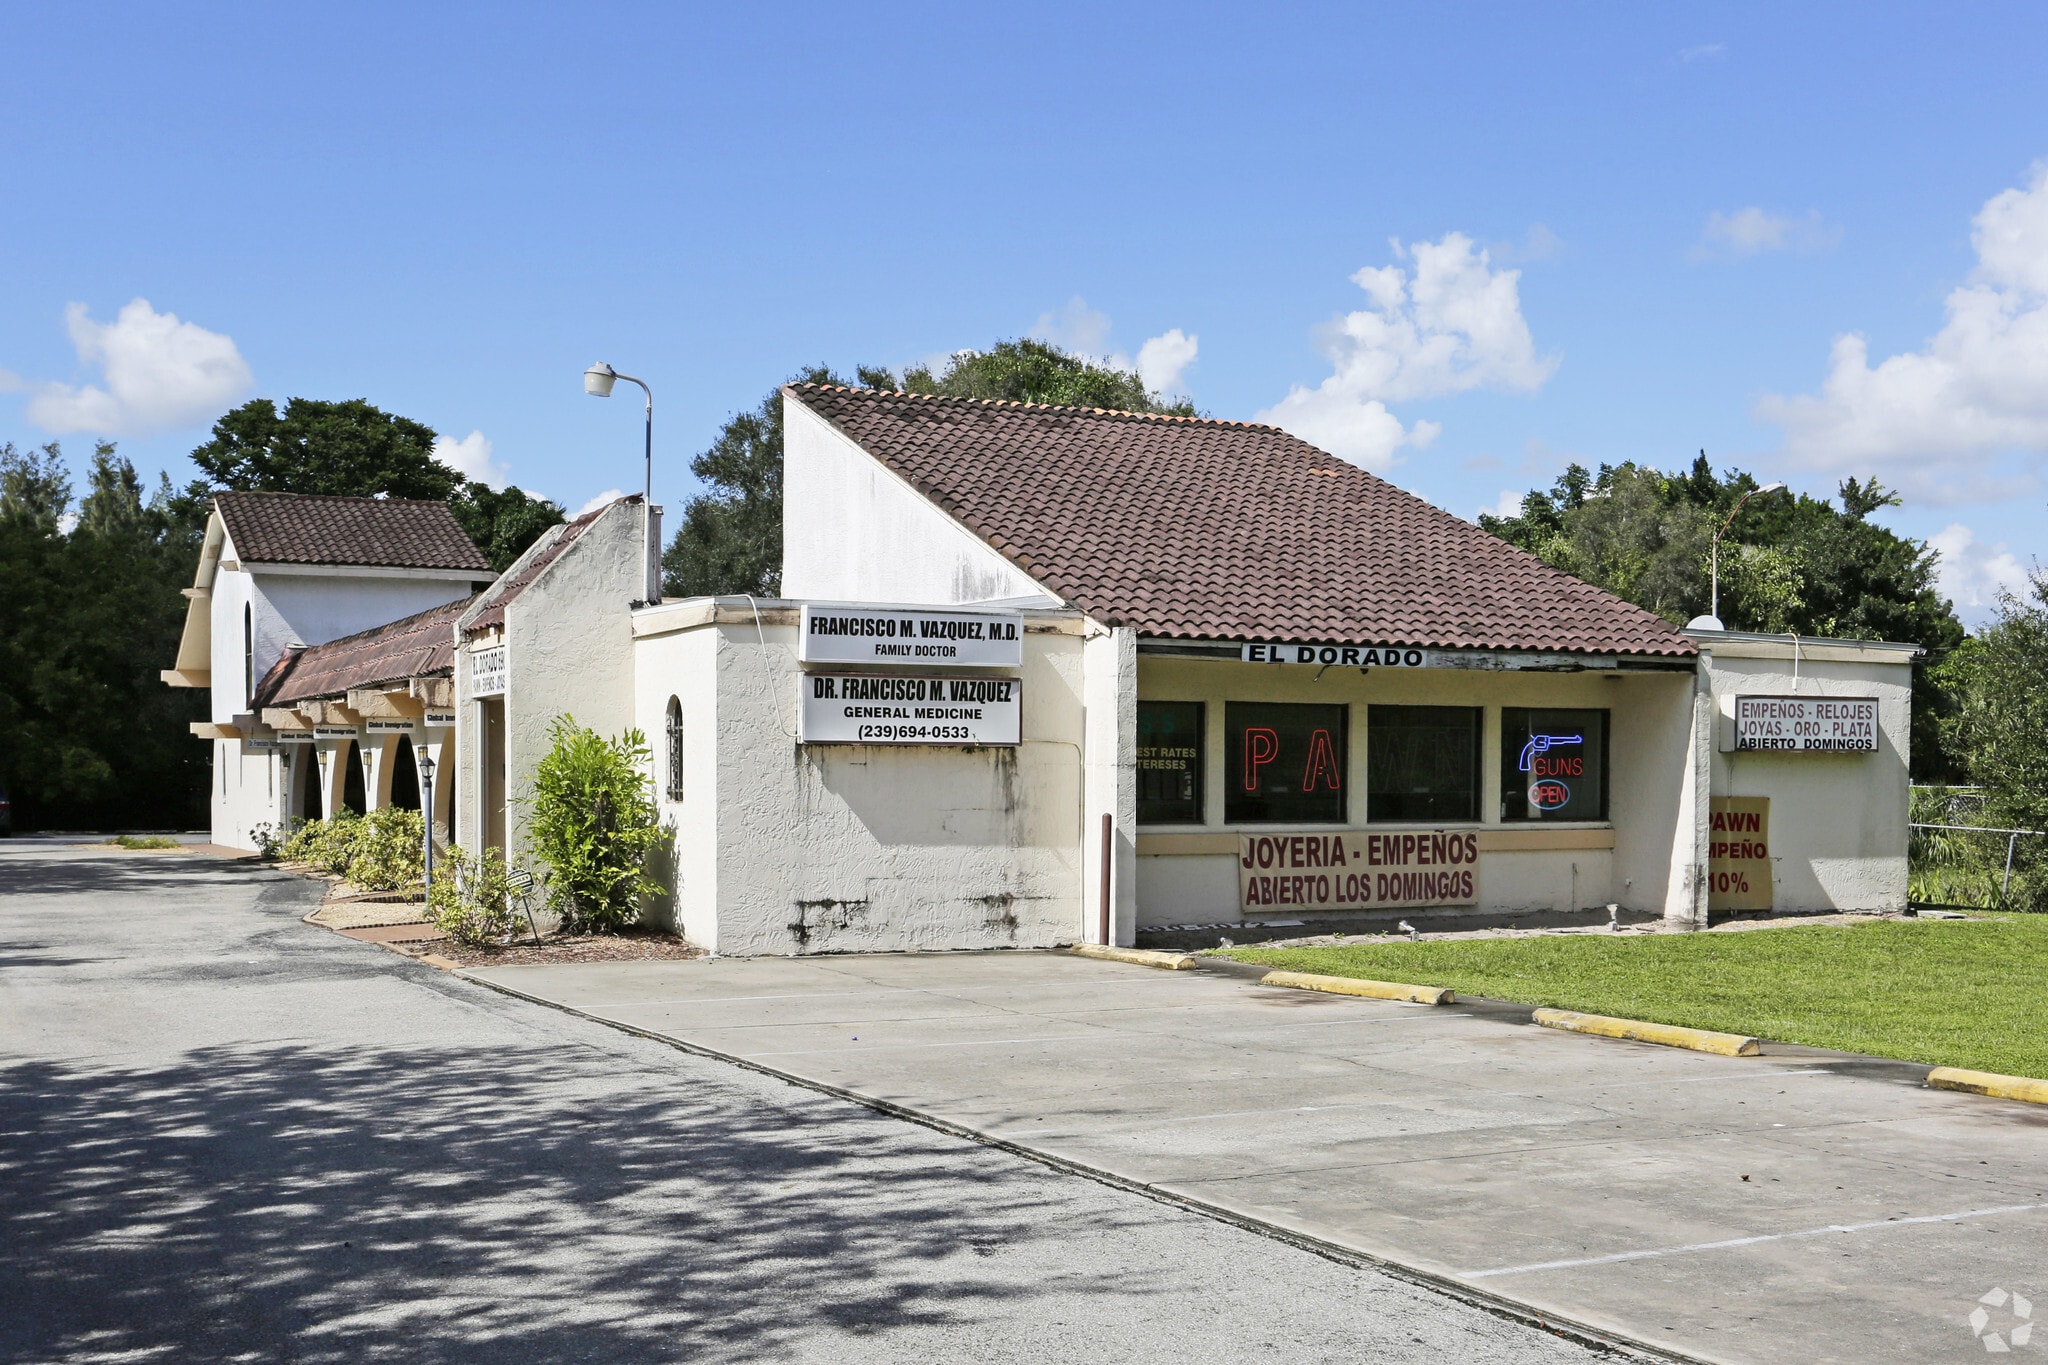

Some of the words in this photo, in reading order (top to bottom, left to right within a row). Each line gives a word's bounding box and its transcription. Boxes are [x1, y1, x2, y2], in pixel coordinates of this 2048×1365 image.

[810, 616, 896, 637] FRANCISCO
[899, 620, 917, 638] M.
[920, 620, 986, 642] VAZQUEZ,
[988, 622, 1019, 641] M.D.
[875, 644, 912, 657] FAMILY
[915, 645, 956, 658] DOCTOR
[1248, 644, 1285, 663] EL
[1297, 646, 1423, 667] DORADO
[813, 677, 838, 699] DR.
[842, 678, 926, 701] FRANCISCO
[929, 680, 946, 702] M.
[950, 681, 1012, 705] VAZQUEZ
[843, 706, 910, 719] GENERAL
[914, 708, 982, 720] MEDICINE
[1816, 704, 1873, 720] RELOJES
[858, 725, 969, 741] (239)694-0533
[1740, 720, 1782, 736] JOYAS
[1794, 721, 1821, 736] ORO
[1833, 722, 1872, 738] PLATA
[1160, 747, 1197, 758] RATES
[1738, 738, 1796, 749] ABIERTO
[1804, 738, 1873, 750] DOMINGOS
[1533, 757, 1583, 776] GUNS
[1530, 786, 1566, 803] OPEN
[1242, 835, 1346, 869] JOYERIA
[1368, 829, 1477, 866] EMPEÑOS
[1246, 874, 1329, 906] ABIERTO
[1336, 873, 1371, 903] LOS
[1377, 870, 1473, 902] DOMINGOS
[1708, 871, 1749, 894] 10%
